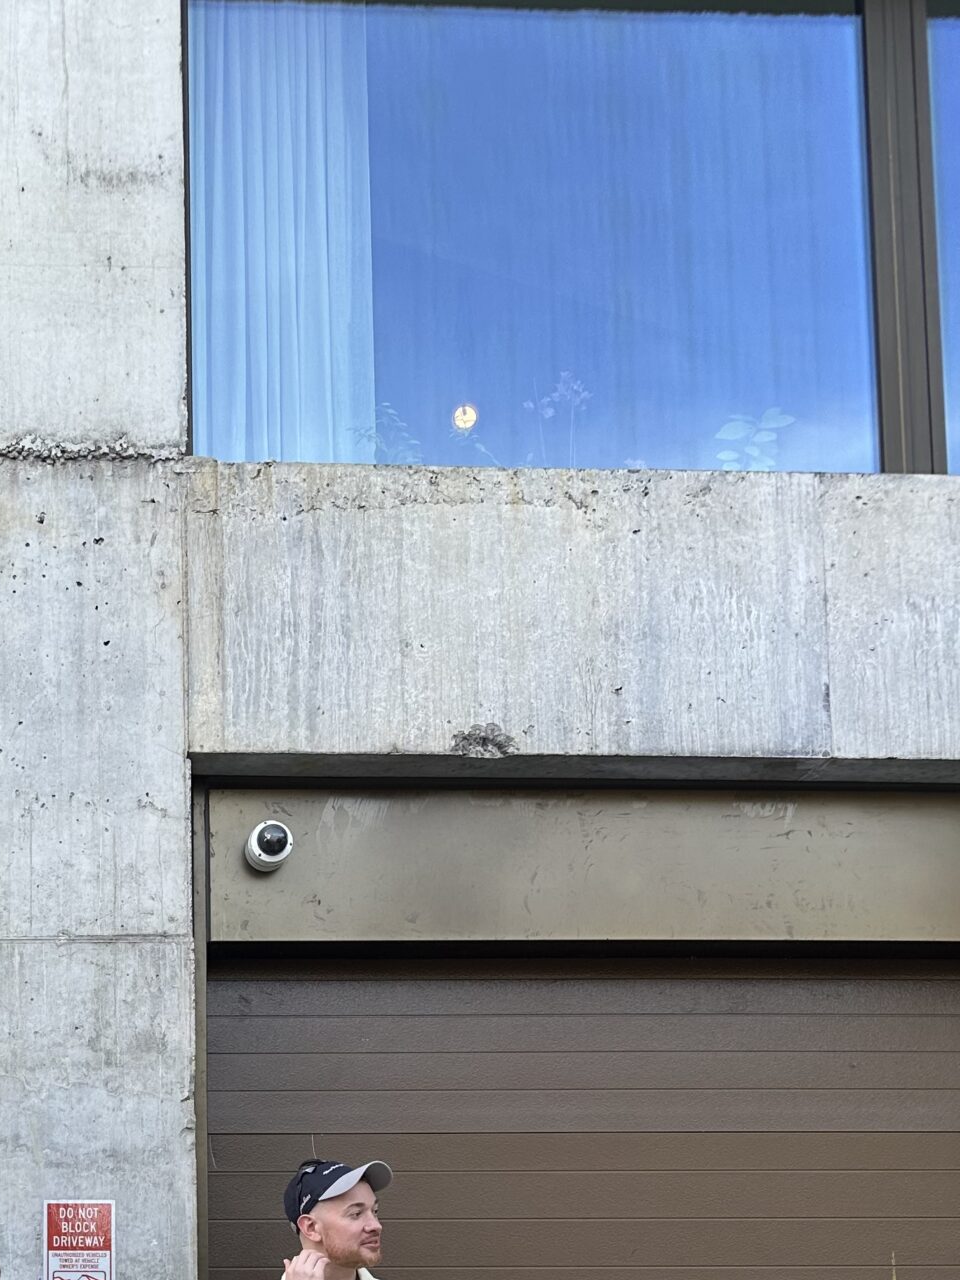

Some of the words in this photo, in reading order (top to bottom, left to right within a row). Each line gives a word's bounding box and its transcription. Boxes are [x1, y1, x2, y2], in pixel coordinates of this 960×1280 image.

[59, 1207, 74, 1219] DO
[78, 1207, 99, 1219] NOT
[61, 1221, 97, 1233] BLOCK
[53, 1235, 106, 1247] DRIVEWAY
